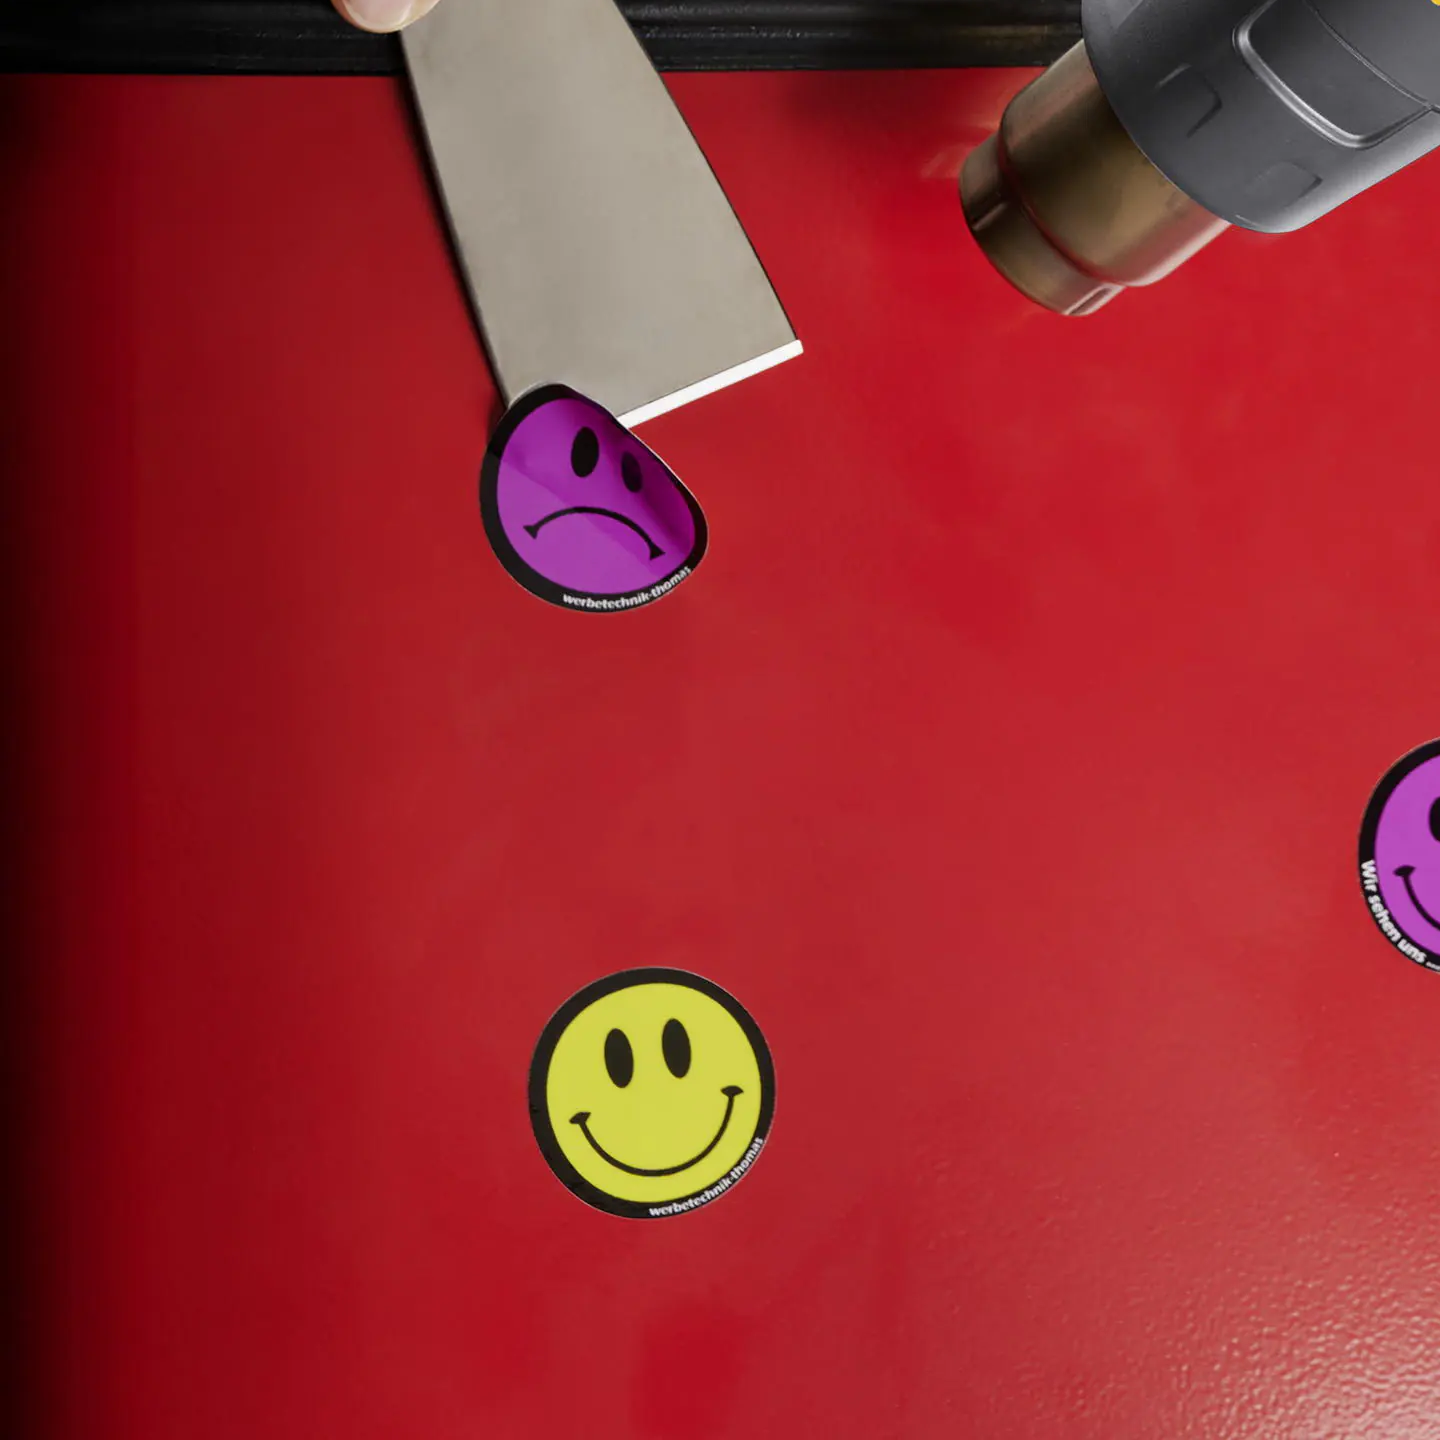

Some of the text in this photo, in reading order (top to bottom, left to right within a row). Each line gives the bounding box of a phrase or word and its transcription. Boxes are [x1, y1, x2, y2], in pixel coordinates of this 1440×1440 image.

[562, 565, 692, 610] werbetechnik-thomas
[1360, 859, 1379, 893] Wir
[1367, 895, 1401, 943] sehen
[1396, 937, 1426, 964] uns
[649, 1136, 765, 1218] werbetechnik-thomas
